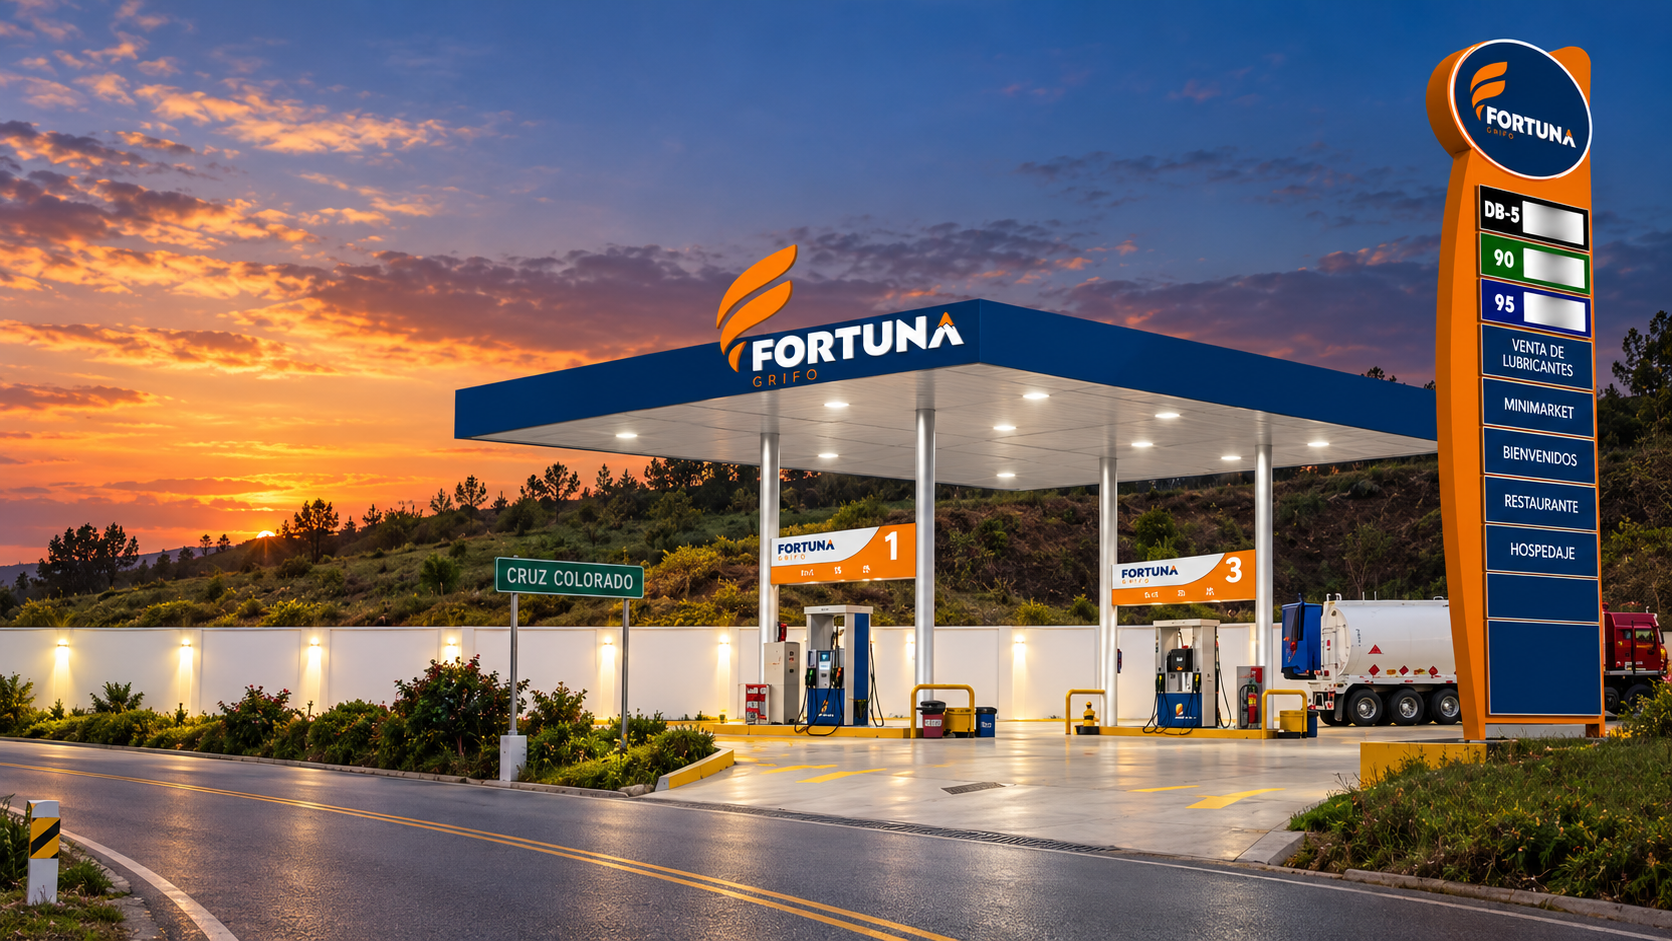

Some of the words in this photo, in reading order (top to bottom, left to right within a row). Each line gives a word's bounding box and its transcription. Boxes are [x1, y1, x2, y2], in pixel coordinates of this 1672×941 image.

[1486, 106, 1577, 149] FORTUNA
[1484, 200, 1520, 224] DB-5
[1493, 248, 1515, 269] 90
[1494, 293, 1515, 313] 95
[752, 311, 965, 372] FORTUNA
[1511, 338, 1548, 356] VENTA
[1549, 344, 1565, 359] DE
[1502, 354, 1574, 377] LUBRICANTES
[752, 368, 818, 388] GRIFO
[1504, 397, 1575, 420] MINIMARKET
[1503, 445, 1578, 467] BIENVENIDOS
[1504, 493, 1579, 514] RESTAURANTE
[777, 539, 836, 555] FORTUNA
[884, 531, 898, 561] 1
[1510, 542, 1576, 560] HOSPEDAJE
[506, 567, 548, 585] CRUZ
[553, 569, 634, 590] COLORADO
[1121, 565, 1179, 579] FORTUNA
[1225, 556, 1243, 584] 3
